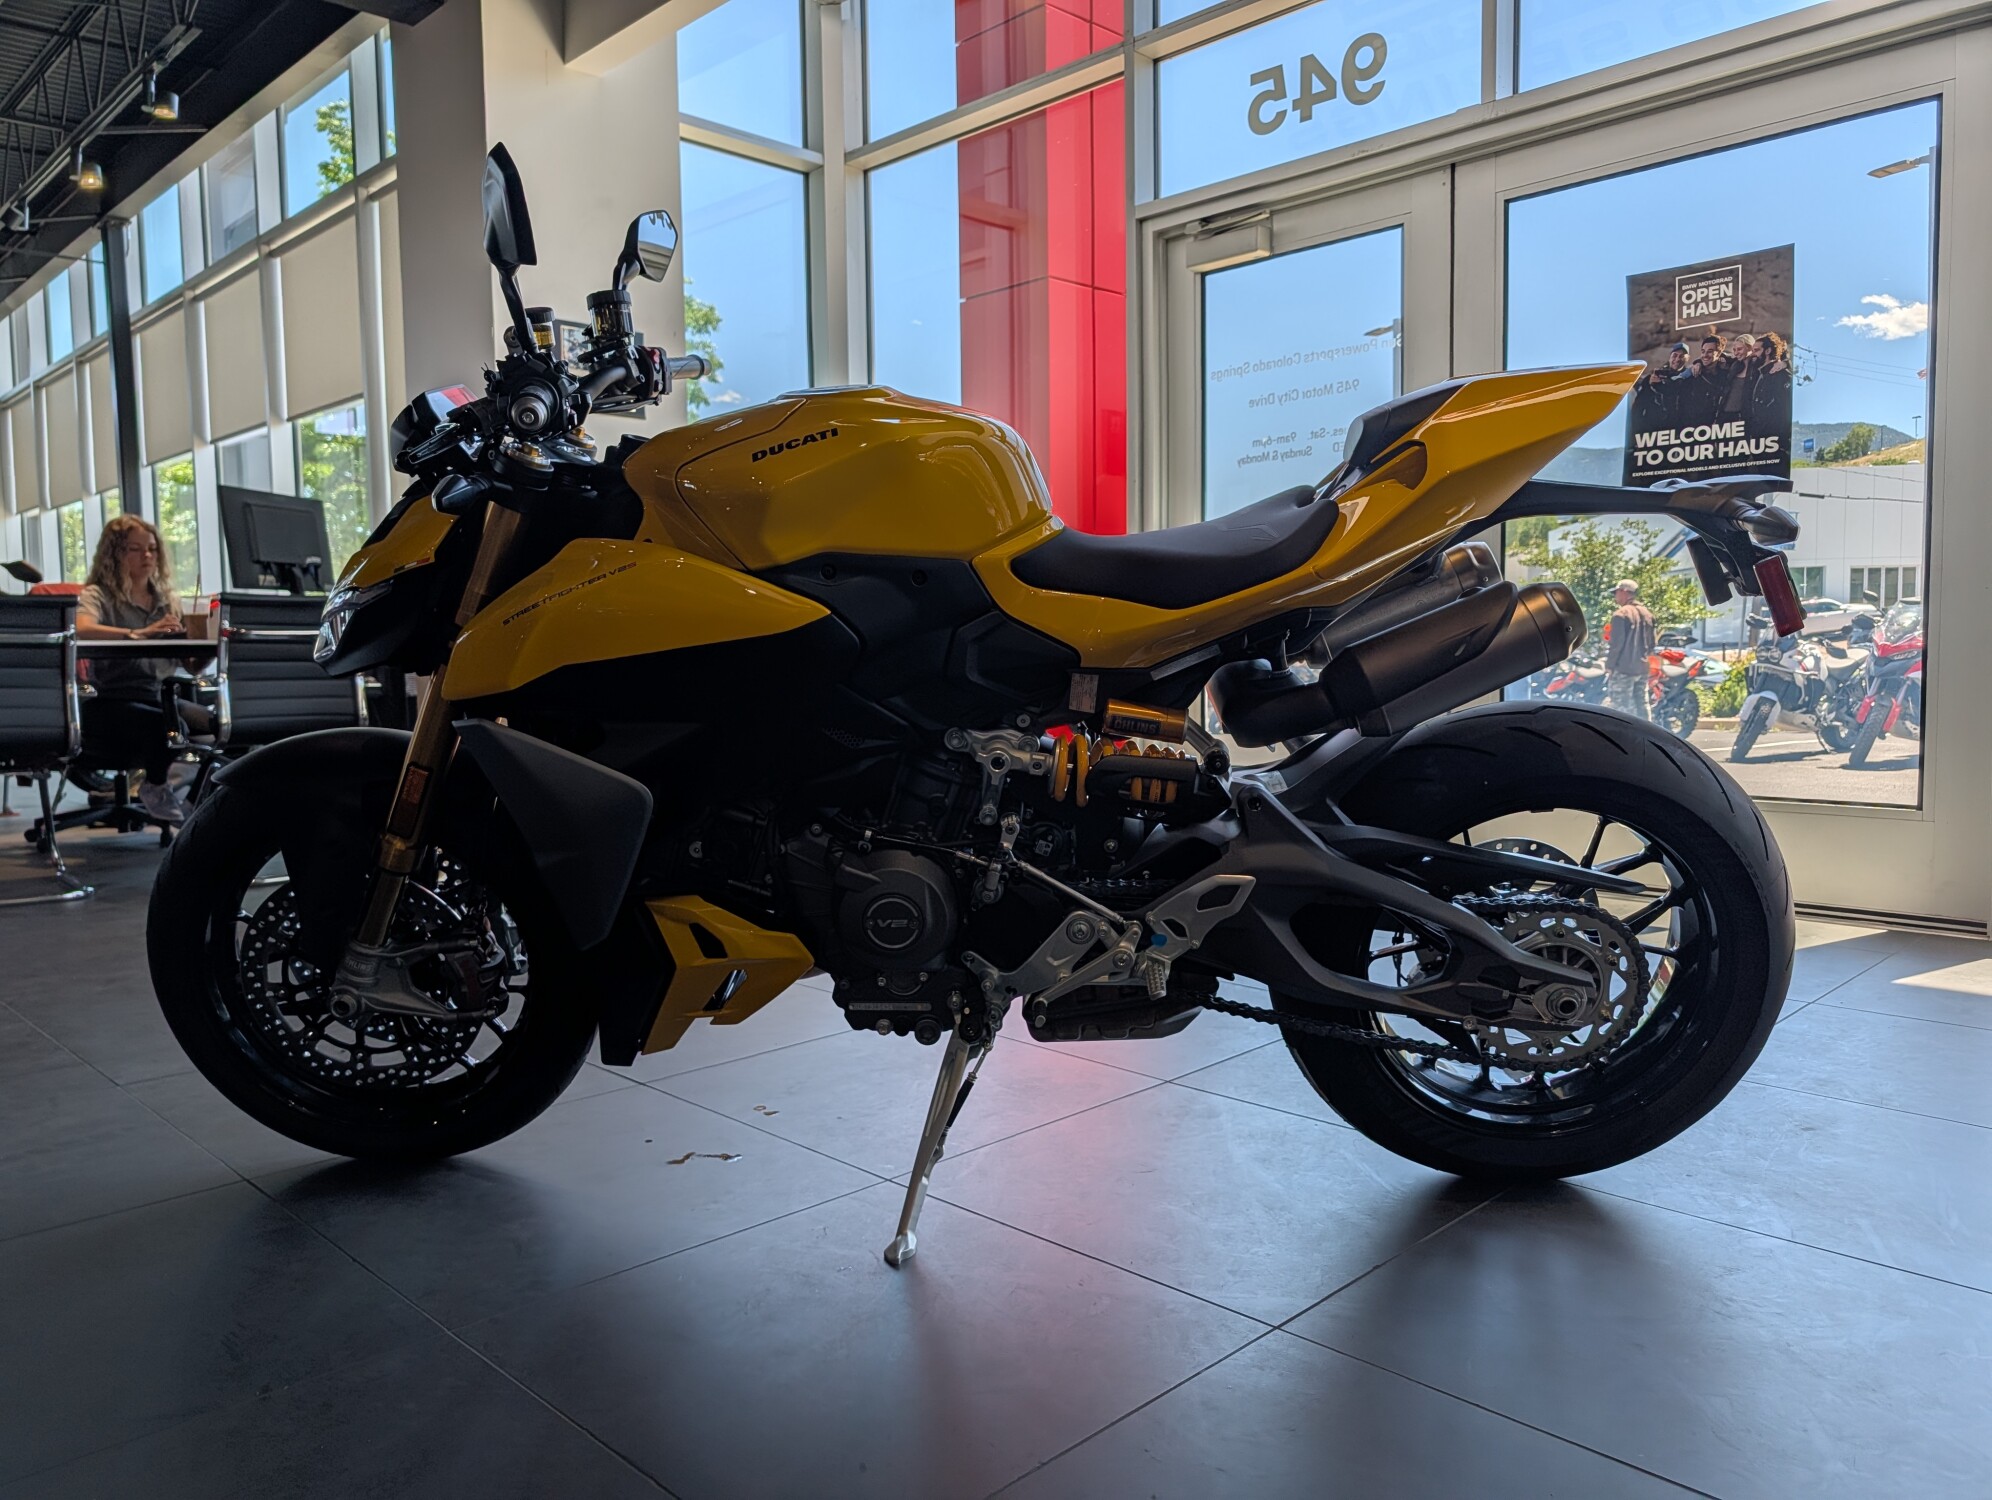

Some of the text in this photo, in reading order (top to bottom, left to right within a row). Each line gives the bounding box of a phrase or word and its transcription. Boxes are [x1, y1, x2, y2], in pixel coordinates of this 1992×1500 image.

[1681, 282, 1733, 305] OPEN
[1698, 276, 1733, 287] MOTORRAD
[1682, 297, 1733, 319] HAUS
[751, 427, 839, 463] DUCATI
[1635, 421, 1745, 449] WELCOME
[1634, 448, 1664, 467] TO
[1667, 443, 1715, 464] OUR
[1718, 435, 1780, 458] HAUS
[502, 573, 607, 626] STREETFIGHTER
